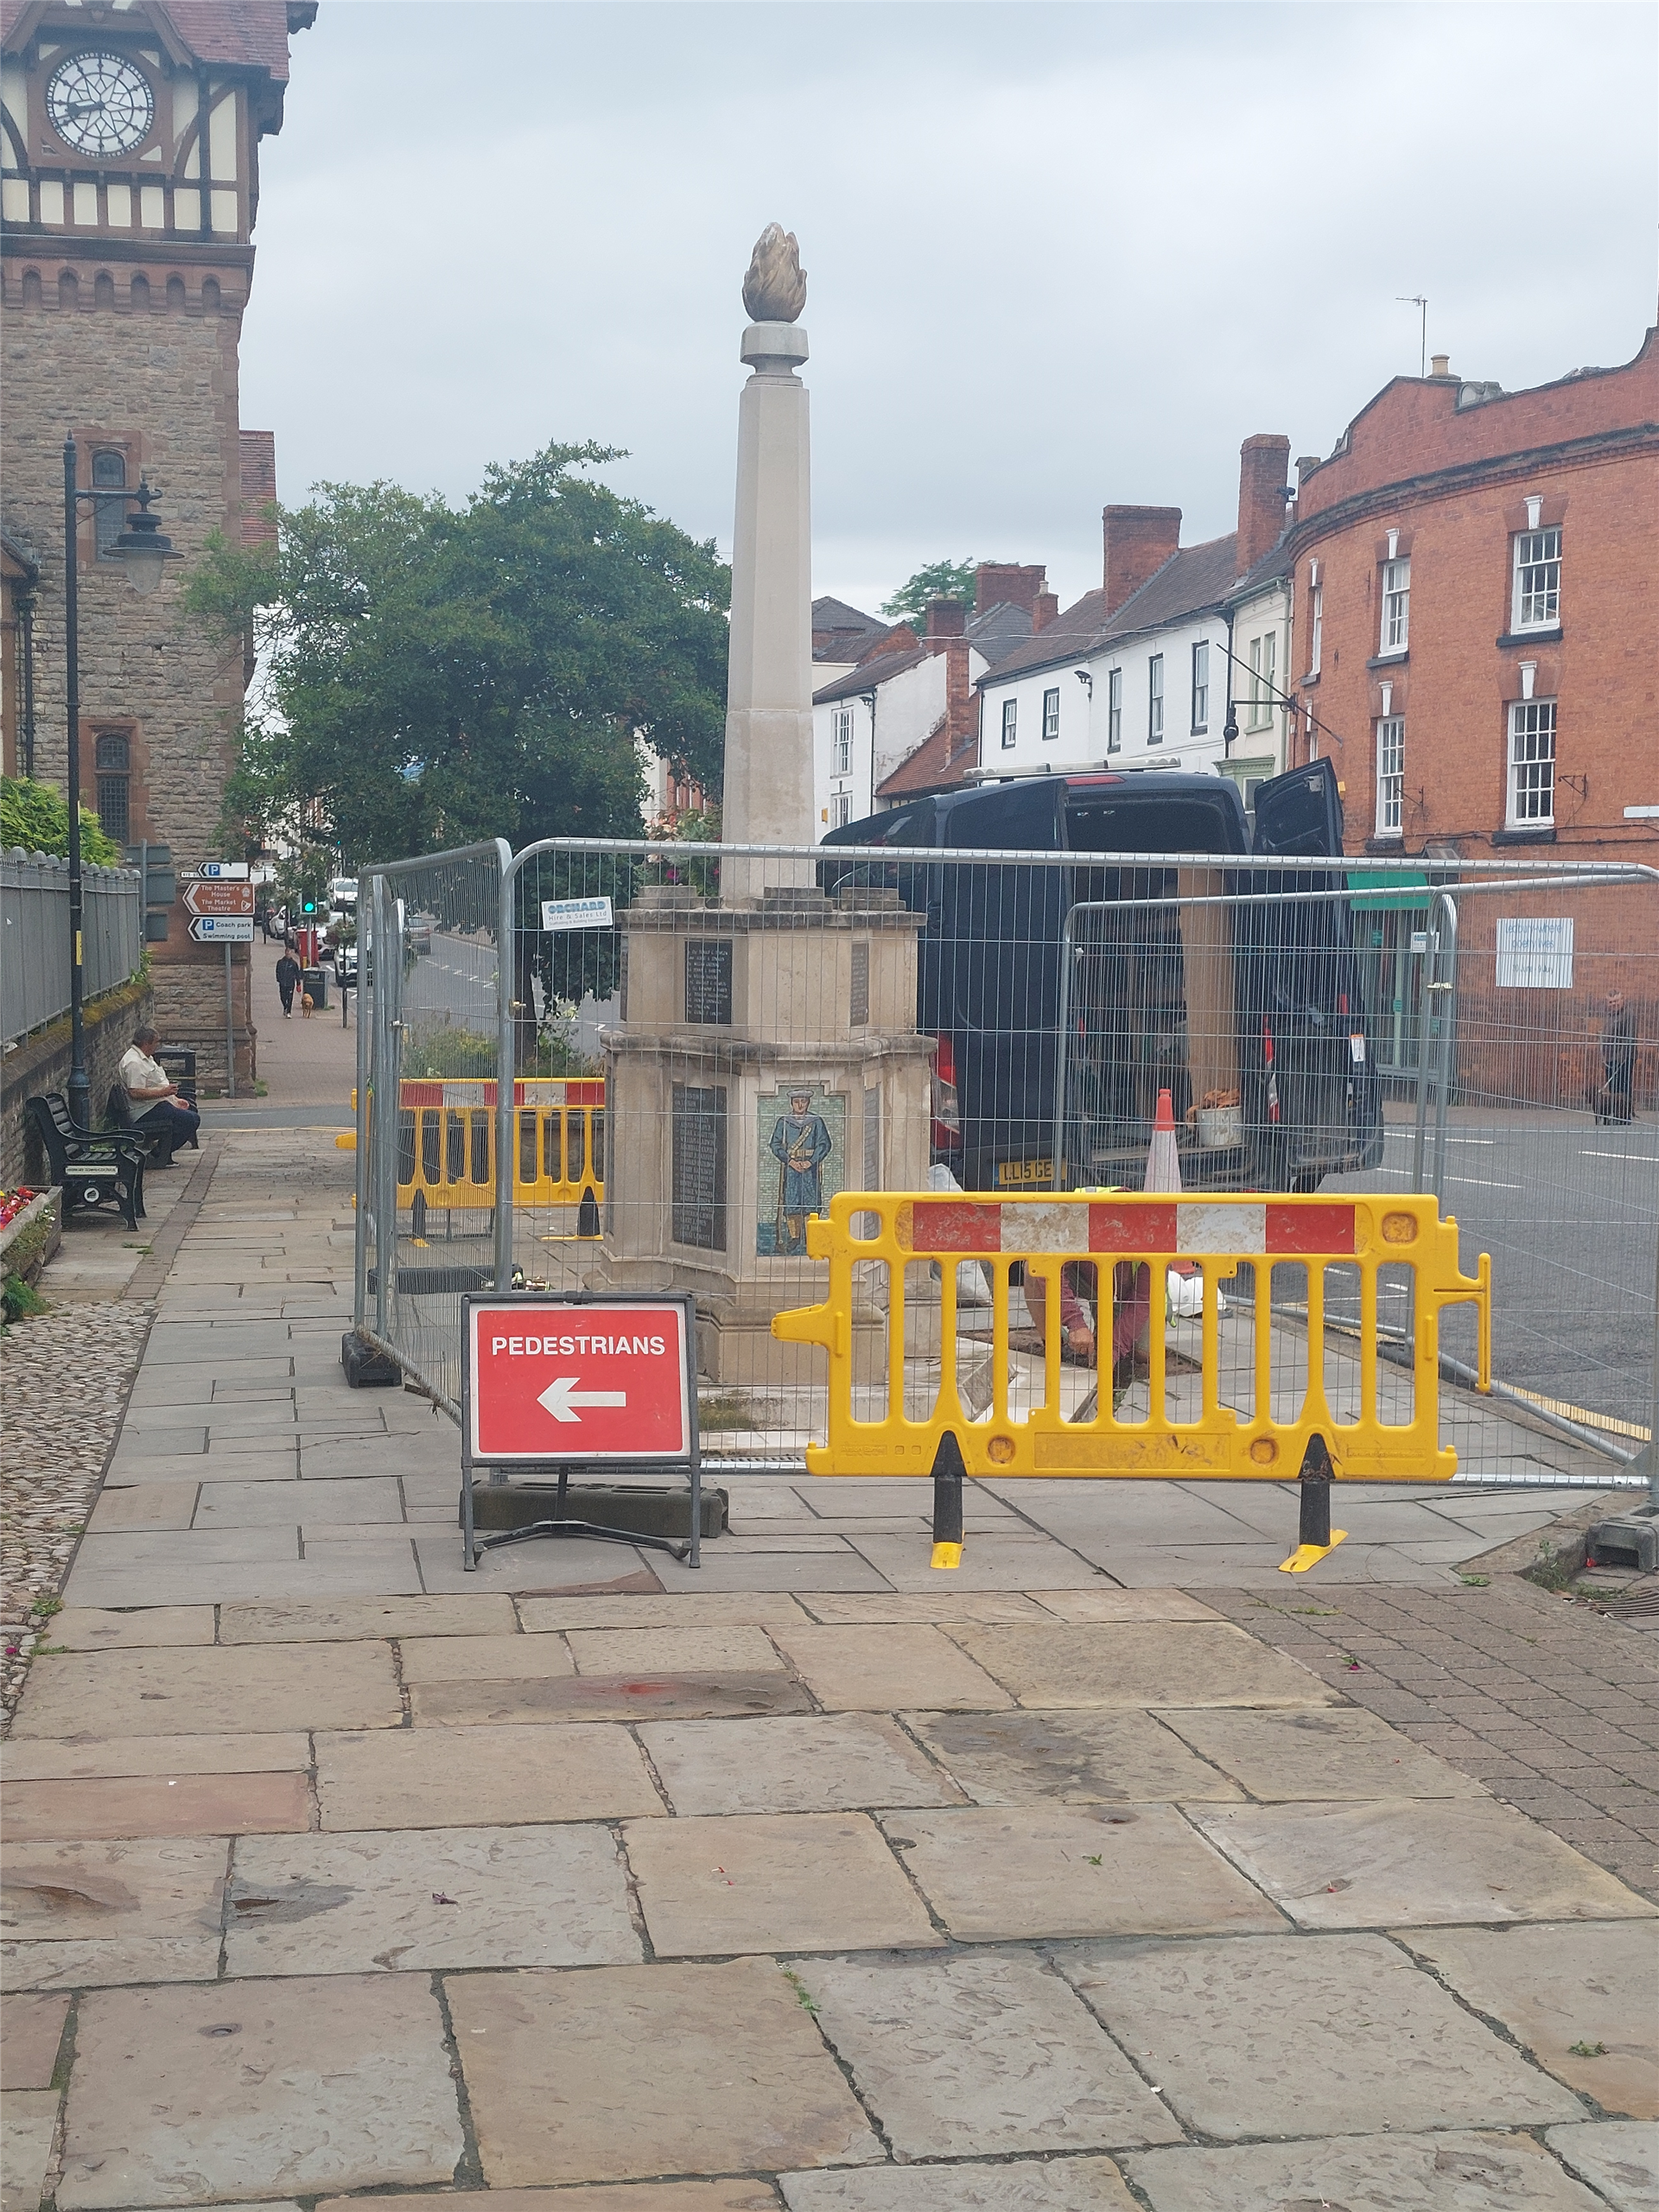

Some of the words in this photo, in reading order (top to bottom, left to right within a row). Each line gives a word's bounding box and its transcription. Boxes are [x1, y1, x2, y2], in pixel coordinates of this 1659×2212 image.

[548, 901, 606, 914] ORCHARD
[1035, 1161, 1053, 1178] GE
[492, 1336, 665, 1356] PEDESTRIANS
